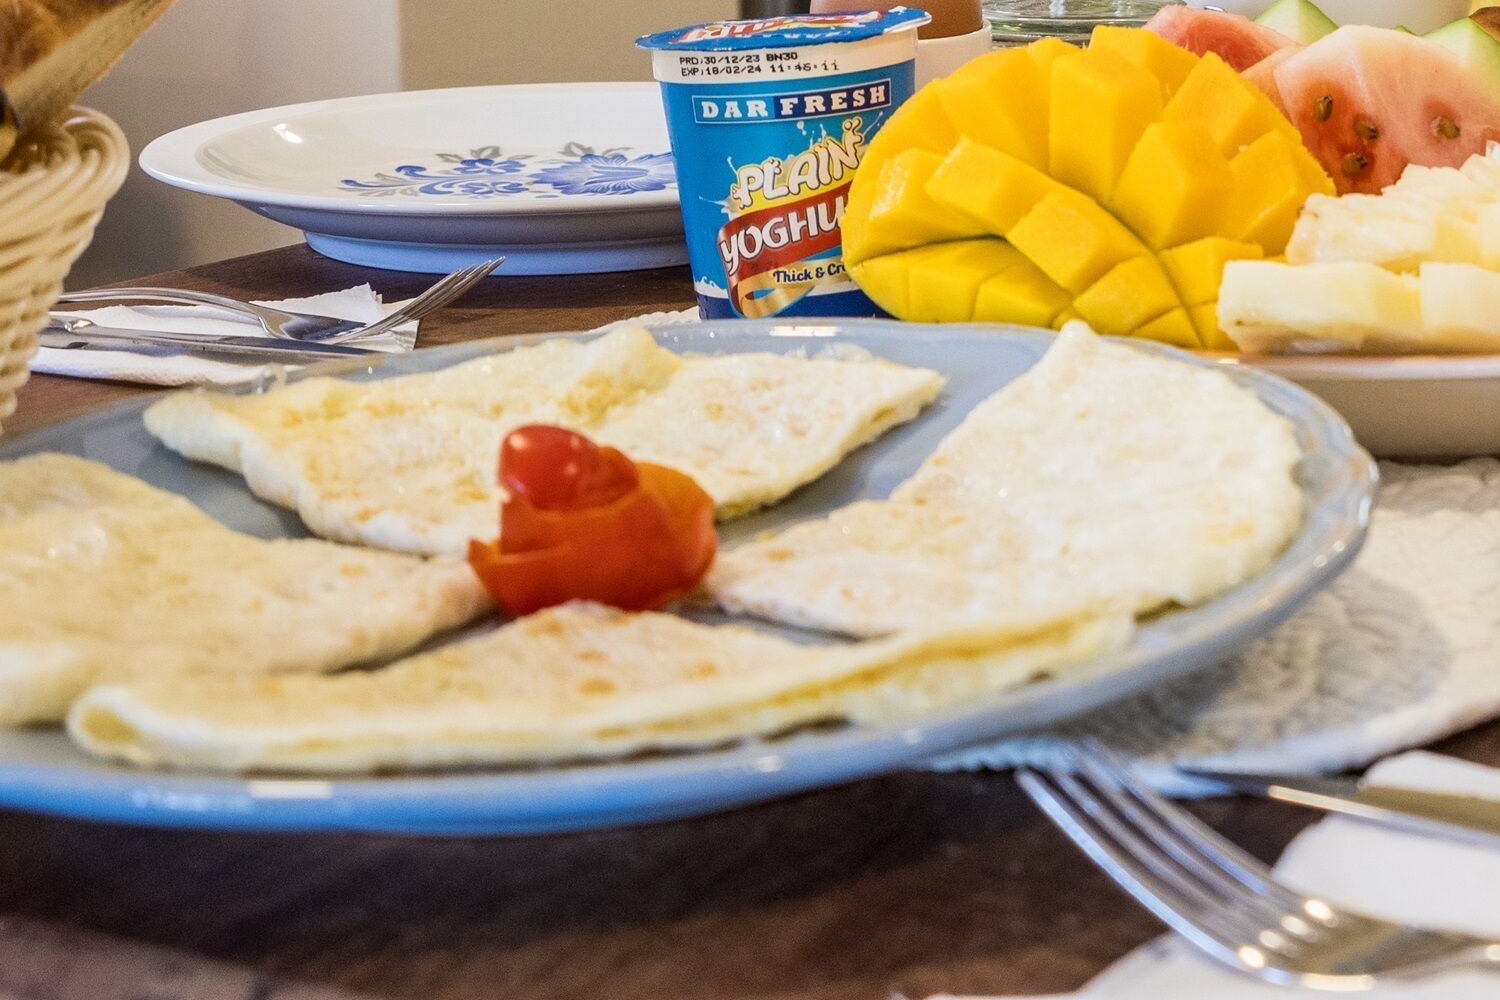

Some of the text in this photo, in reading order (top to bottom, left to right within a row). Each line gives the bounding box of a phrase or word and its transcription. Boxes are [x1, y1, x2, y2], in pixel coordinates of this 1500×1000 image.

[766, 51, 798, 62] BN30
[701, 84, 887, 119] DAR FRESH
[731, 117, 864, 209] PLAIN
[773, 268, 813, 282] Thick
[815, 266, 825, 279] &
